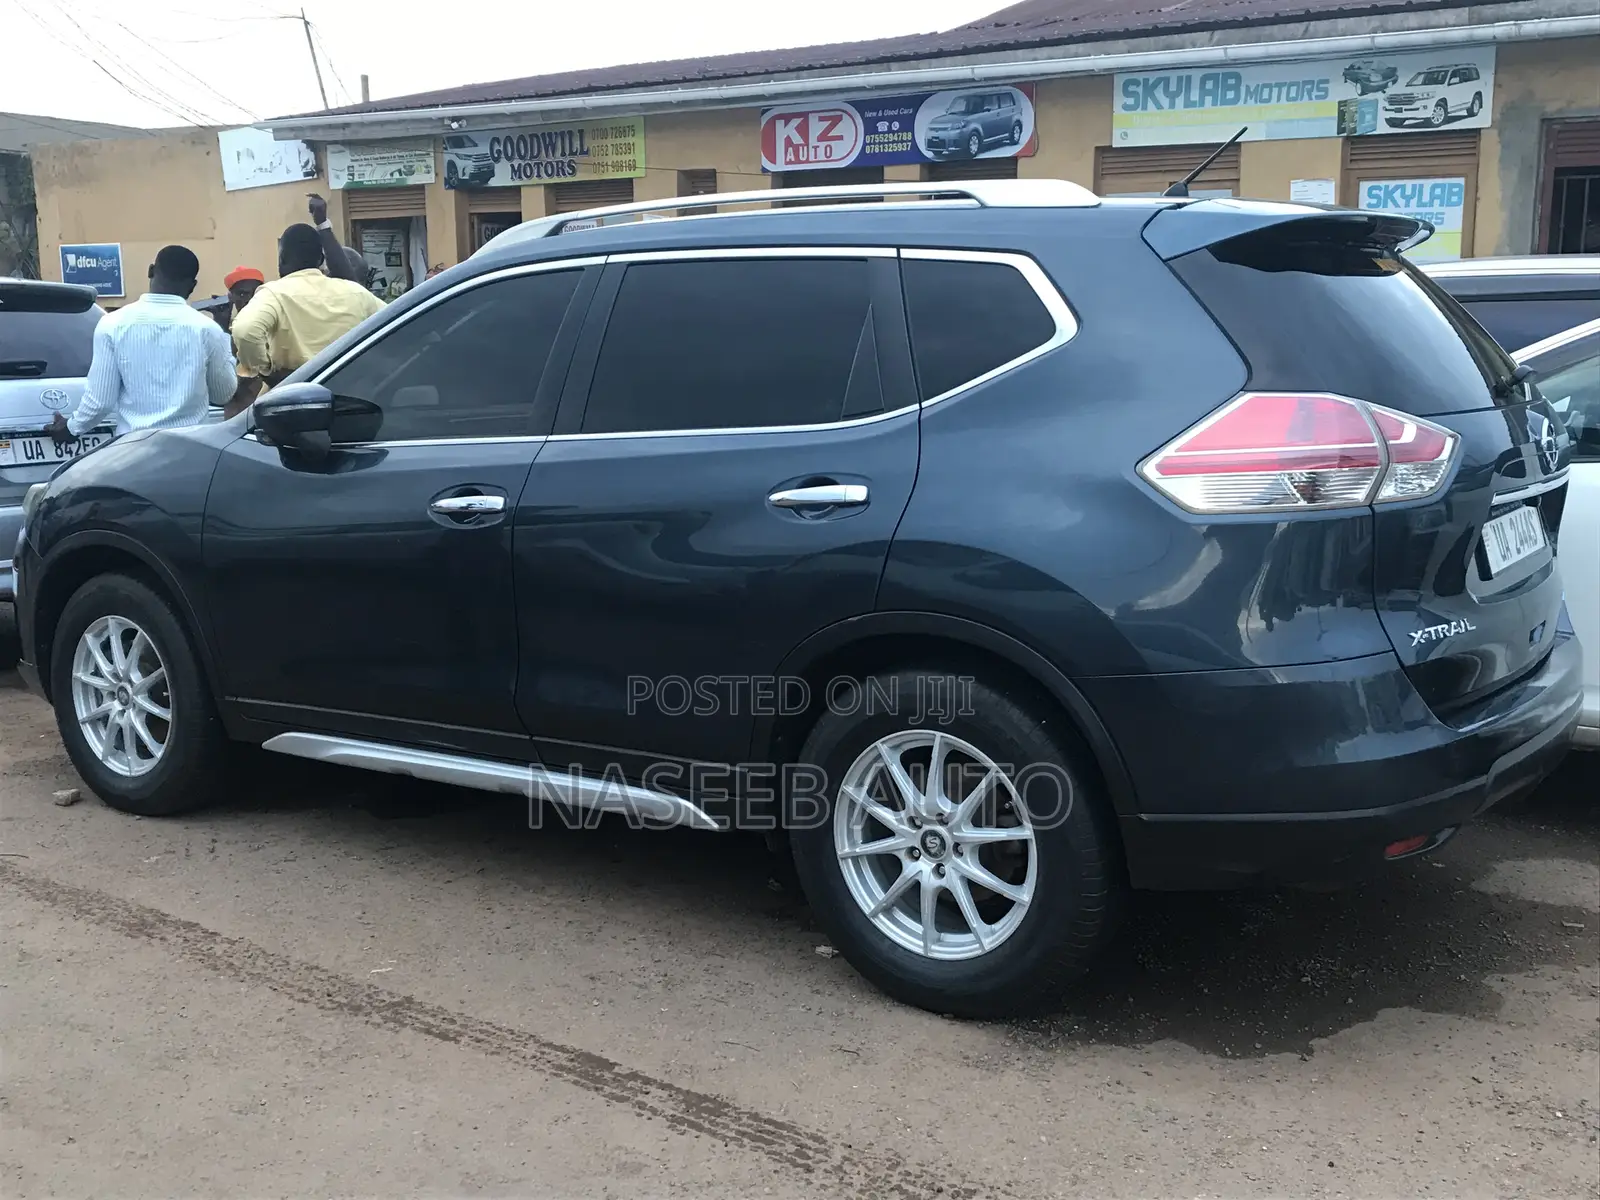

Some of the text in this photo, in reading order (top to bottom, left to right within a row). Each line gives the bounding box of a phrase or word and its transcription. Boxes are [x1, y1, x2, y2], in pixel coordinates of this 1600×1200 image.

[1121, 71, 1330, 112] SKYLAB MOTORS
[865, 110, 877, 118] New
[884, 108, 899, 117] Used
[899, 107, 913, 115] Cars
[489, 129, 590, 164] GOODWILL
[786, 144, 833, 162] AUTO
[865, 142, 912, 154] 0781325937
[510, 159, 577, 181] MOTORS
[1366, 182, 1465, 209] SKYLAB
[76, 255, 118, 271] dfcu Agent
[22, 440, 45, 460] UA
[1407, 617, 1477, 647] X-TRAIL
